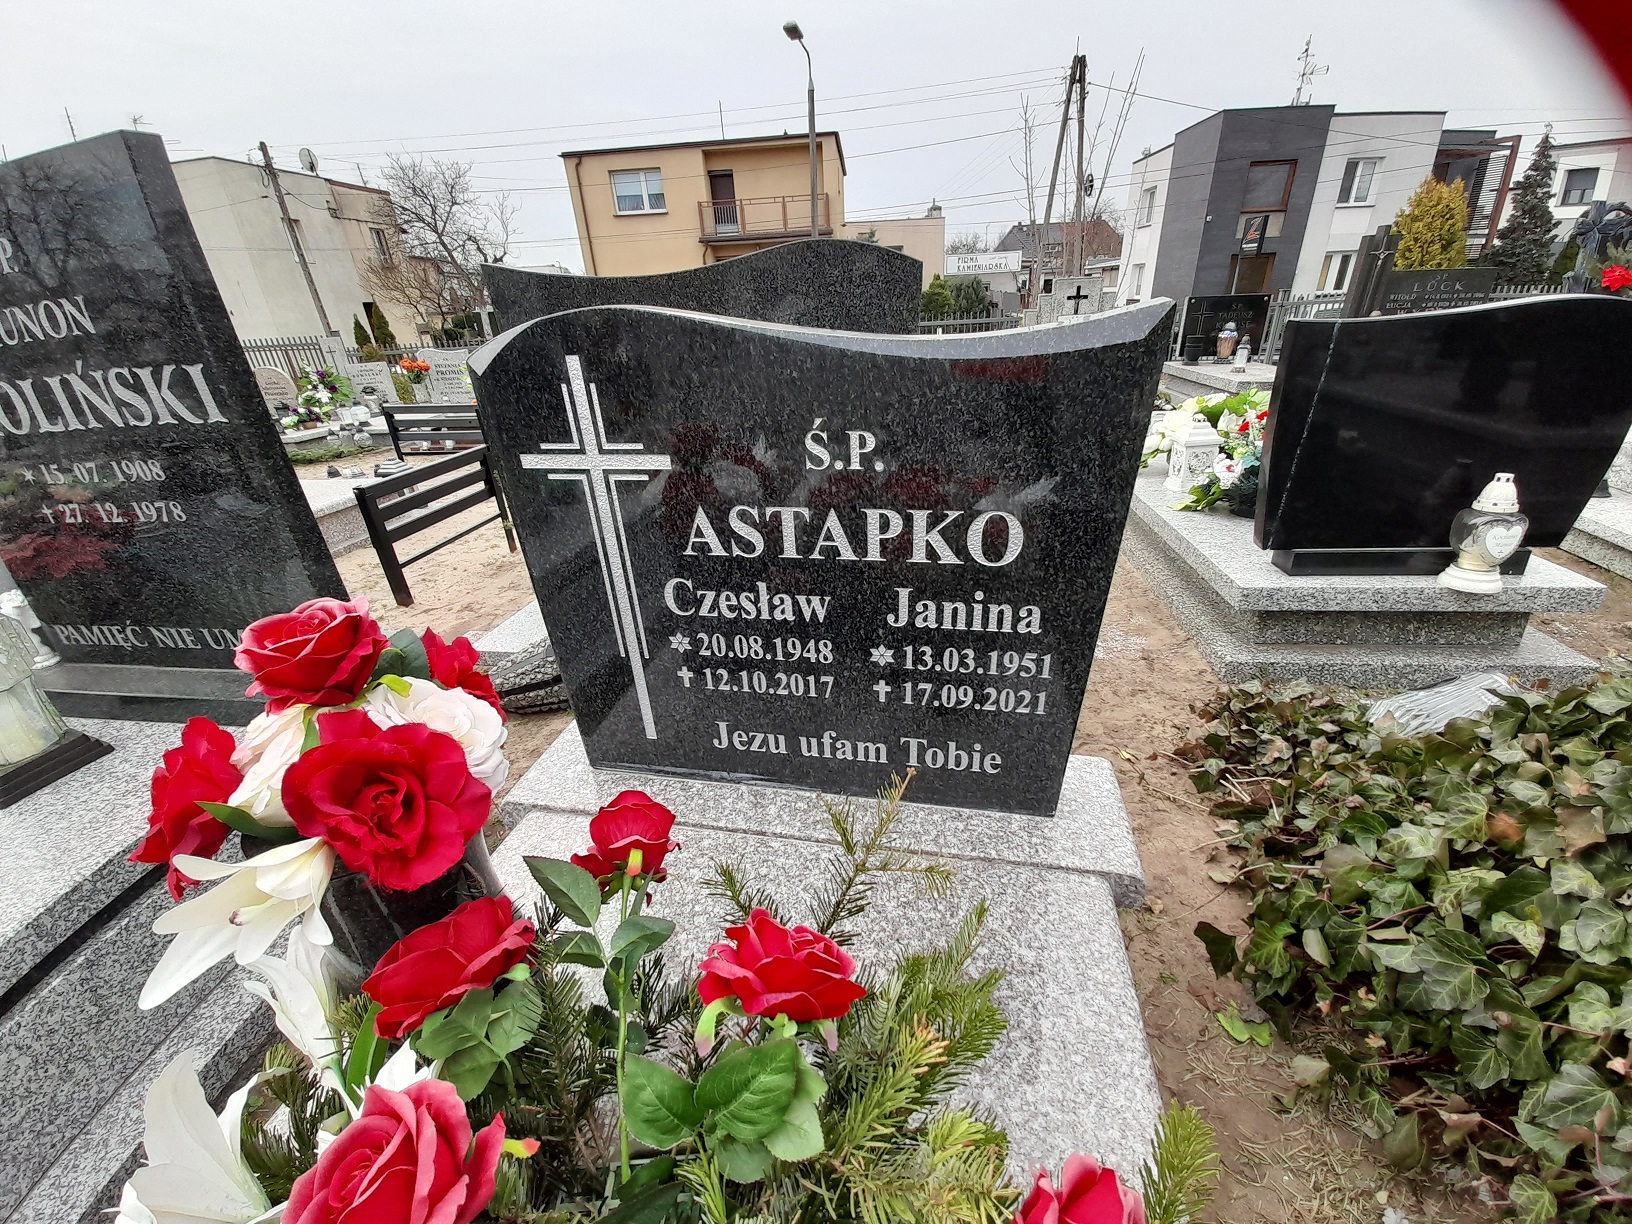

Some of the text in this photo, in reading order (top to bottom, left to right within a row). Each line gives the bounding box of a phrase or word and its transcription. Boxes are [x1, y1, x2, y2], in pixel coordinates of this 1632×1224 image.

[957, 256, 979, 264] FIRMA
[0, 295, 97, 347] UNON
[0, 359, 230, 437] OLIŃSKI
[804, 418, 885, 472] Ś.P.
[110, 459, 167, 482] 1908
[130, 500, 187, 523] 1978
[682, 505, 1024, 567] ASTAPKO
[663, 577, 832, 623] Czesław
[887, 587, 1042, 634] Janina
[51, 619, 244, 651] PAMIĘĆ NIE UM
[697, 632, 834, 664] 20.08.1948
[902, 645, 1052, 679] 13.03.1951
[702, 667, 834, 699] 12.10.2017
[902, 682, 1048, 715] 17.09.2021
[712, 721, 1002, 774] Jezu ufam Tobie
